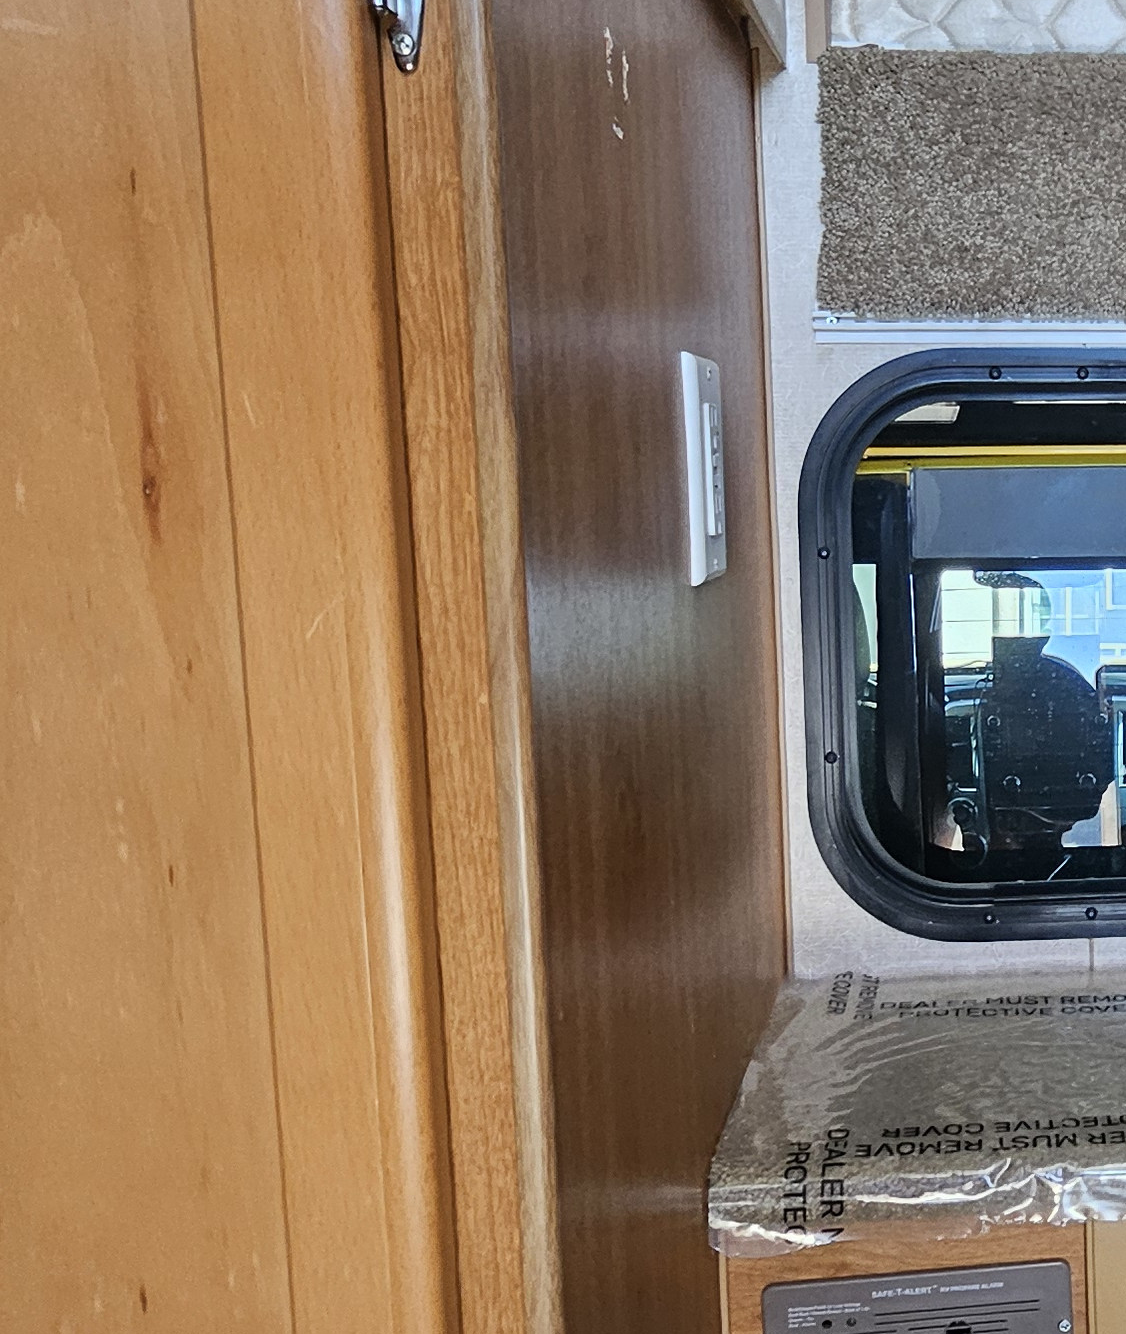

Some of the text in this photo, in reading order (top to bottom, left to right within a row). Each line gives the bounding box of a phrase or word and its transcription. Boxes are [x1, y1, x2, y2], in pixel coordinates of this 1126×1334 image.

[985, 994, 1051, 1006] MUST
[881, 1122, 985, 1139] COVER
[854, 1138, 984, 1158] REMOVE
[992, 1133, 1078, 1152] MUST
[820, 1128, 850, 1219] DEALER
